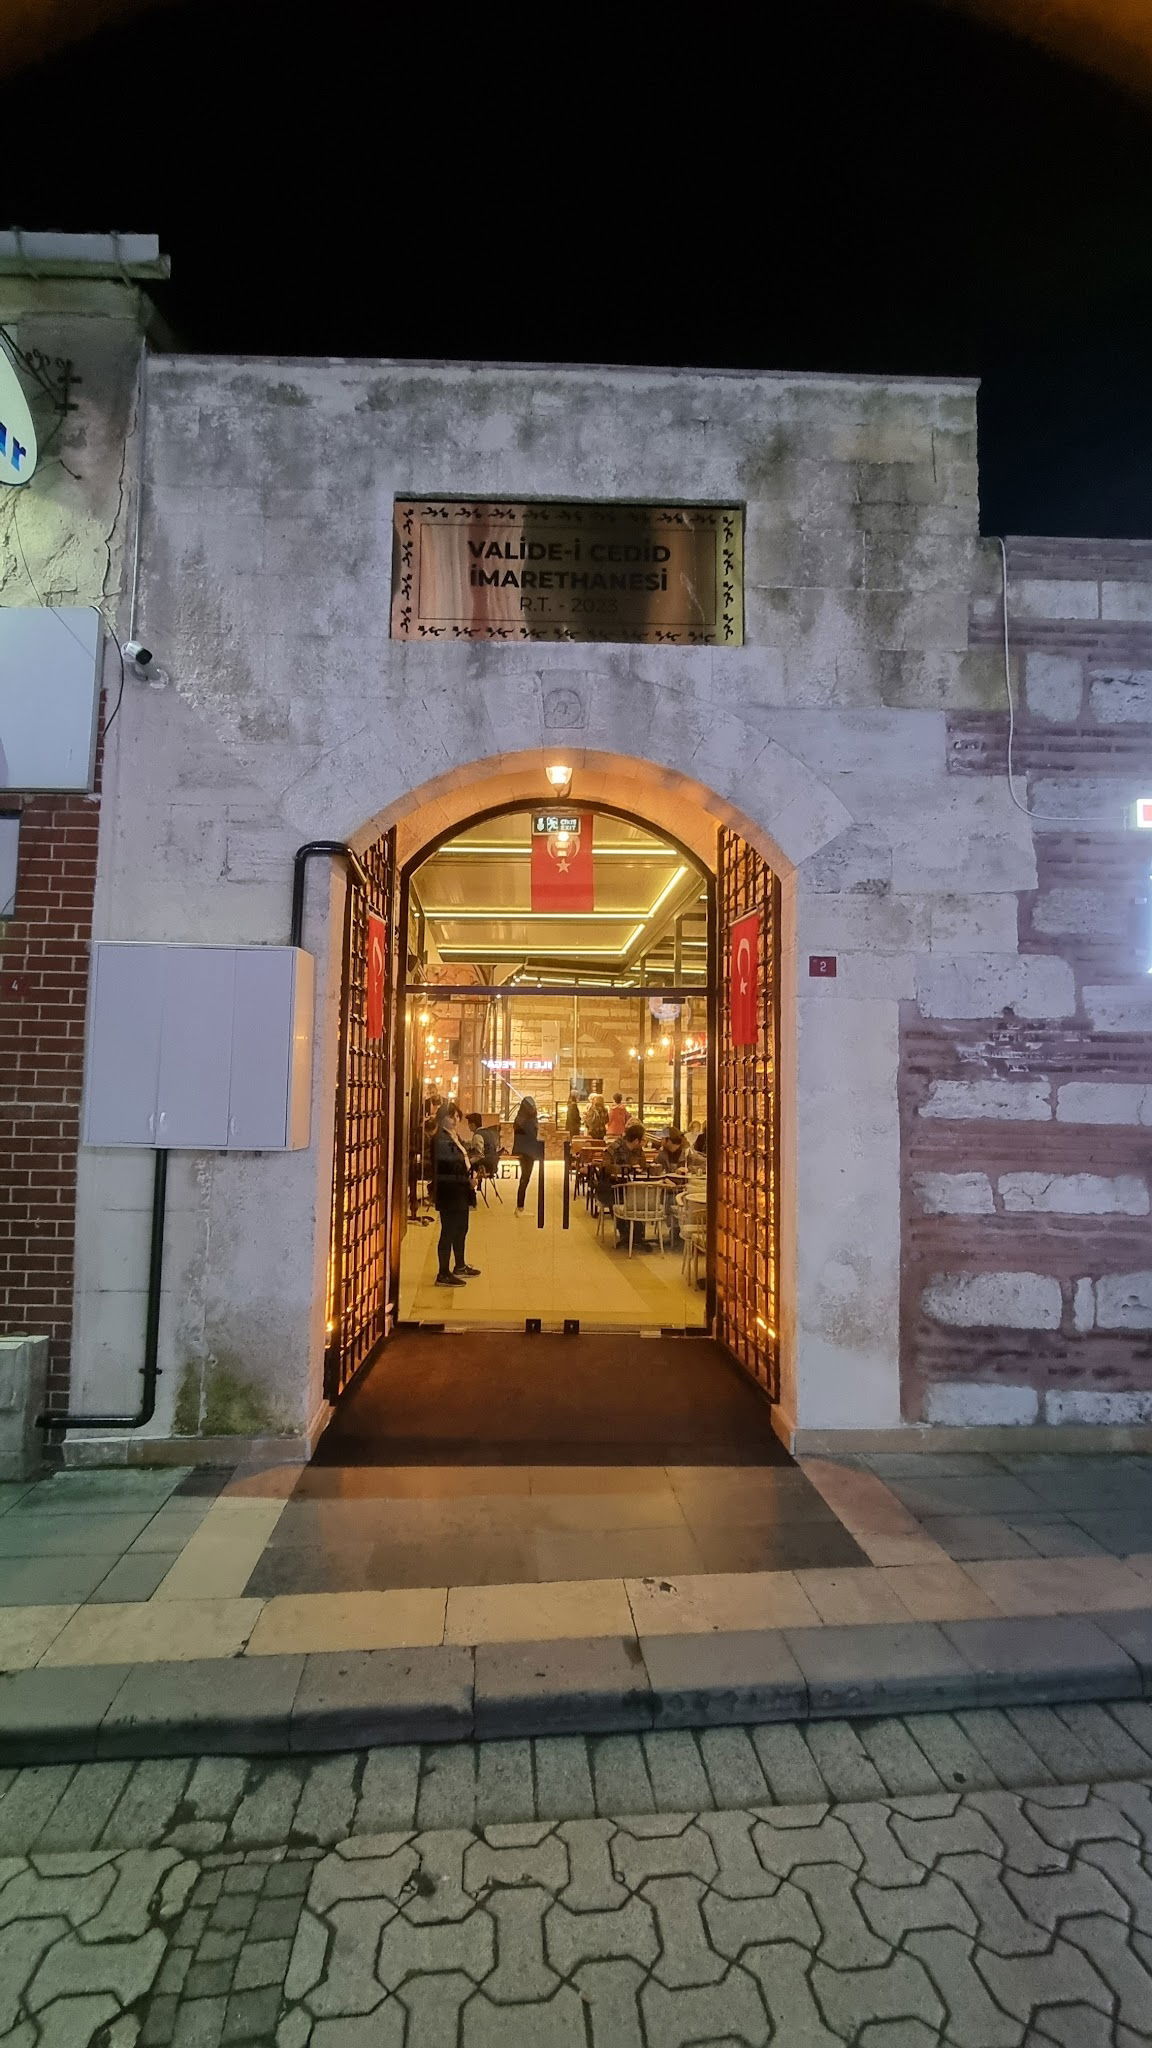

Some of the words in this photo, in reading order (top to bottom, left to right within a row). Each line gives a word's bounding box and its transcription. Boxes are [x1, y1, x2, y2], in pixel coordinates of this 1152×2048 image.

[467, 537, 581, 560] VALİDE-İ
[590, 538, 671, 562] CEDİD
[470, 563, 668, 591] İMARETHANESİ
[520, 597, 552, 612] R.T.
[820, 960, 827, 972] 2
[11, 979, 18, 991] 4
